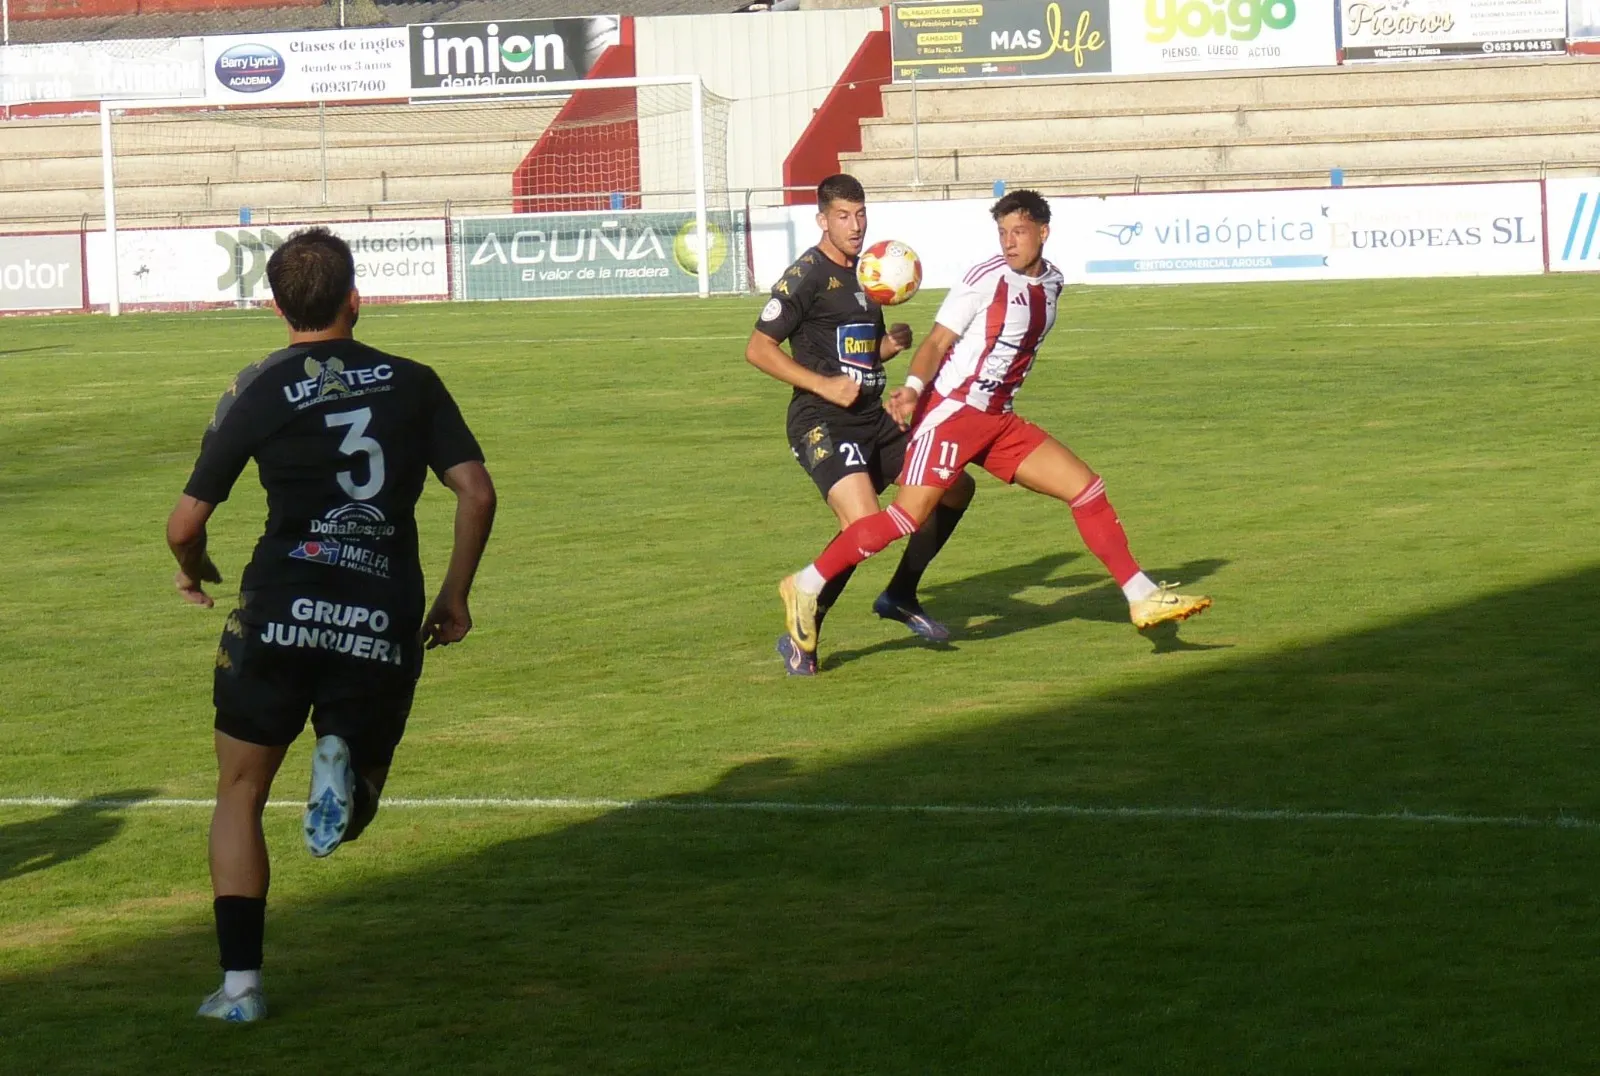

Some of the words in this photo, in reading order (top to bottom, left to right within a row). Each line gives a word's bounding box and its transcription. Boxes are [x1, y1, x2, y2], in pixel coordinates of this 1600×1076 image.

[990, 28, 1042, 50] MAS
[1046, 2, 1106, 68] life
[1144, 0, 1297, 43] yoigo
[289, 39, 335, 53] Clases
[339, 38, 357, 50] de
[422, 23, 565, 76] imion
[1207, 44, 1239, 56] LUEGO
[1494, 42, 1511, 51] 633
[1513, 41, 1525, 50] 94
[1526, 41, 1538, 50] 94
[1539, 40, 1552, 49] 95
[221, 57, 248, 69] Barry
[249, 54, 279, 68] Lynch
[340, 63, 352, 72] os
[354, 61, 361, 71] 3
[229, 76, 272, 86] ACADEMIA
[310, 80, 386, 94] 609317400
[470, 220, 666, 265] ACUÑA
[1154, 216, 1314, 249] vilaóptica
[1491, 216, 1536, 245] SL
[521, 269, 536, 281] El
[538, 268, 574, 281] valor
[576, 267, 596, 279] de
[598, 267, 612, 279] la
[615, 266, 669, 279] madera
[1133, 259, 1174, 270] CENTRO
[1175, 258, 1230, 270] COMERCIAL
[1231, 256, 1273, 268] AROUSA
[283, 363, 395, 403] UFATEC
[324, 406, 385, 501] 3
[940, 441, 959, 467] 11
[341, 544, 390, 571] IMELFA
[291, 598, 390, 633] GRUPO
[260, 622, 401, 665] JUNQUERA
